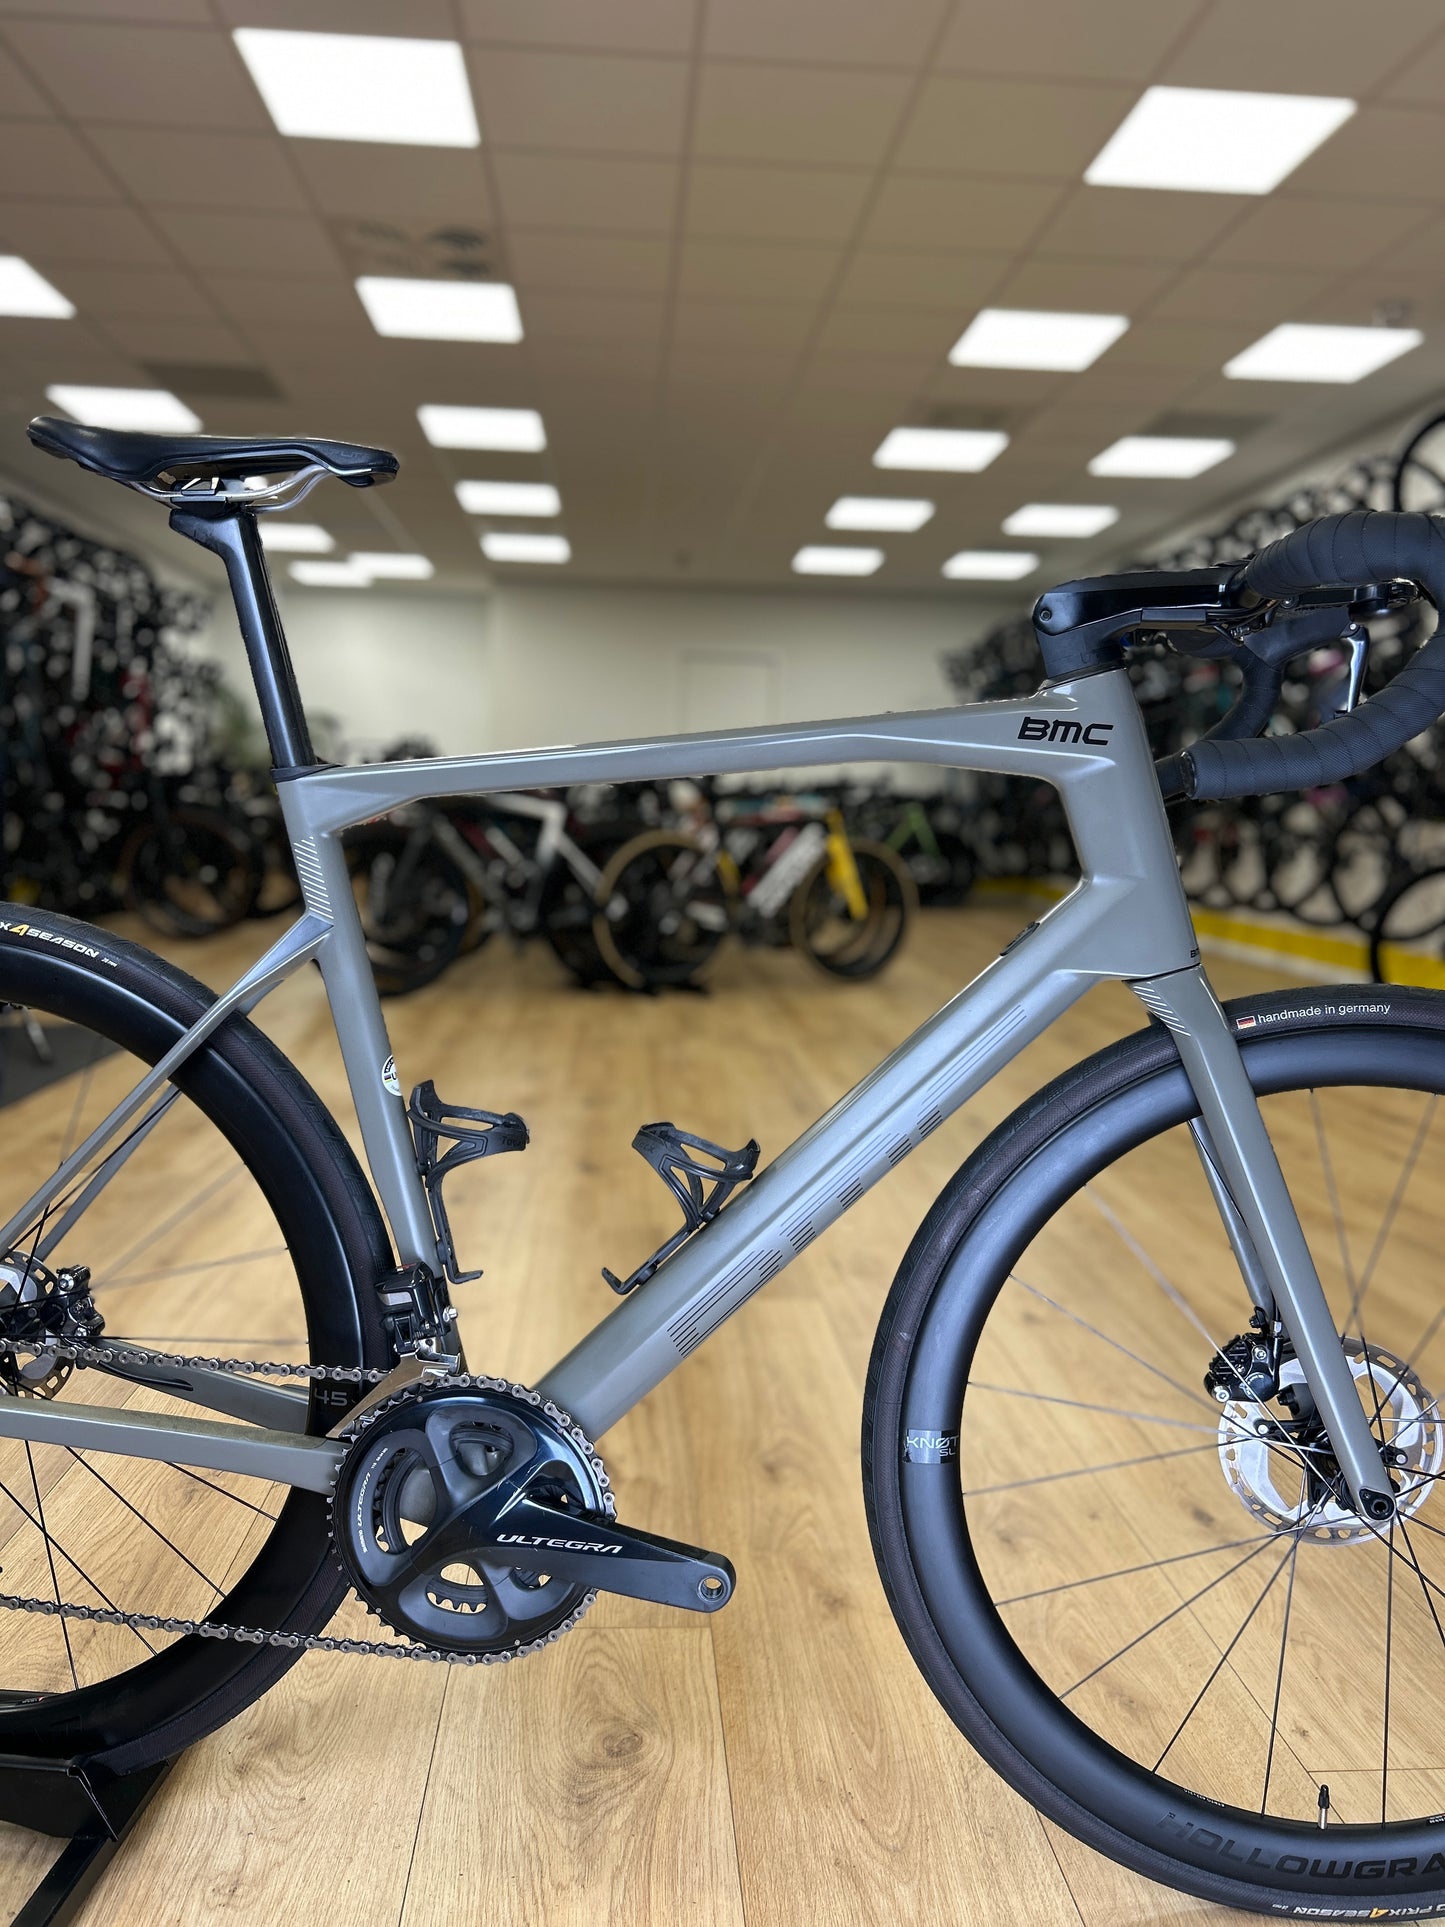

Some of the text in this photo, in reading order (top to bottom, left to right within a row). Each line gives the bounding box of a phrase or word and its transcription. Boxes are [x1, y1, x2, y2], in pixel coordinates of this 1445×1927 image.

[1018, 716, 1114, 746] BMC
[1257, 1003, 1391, 1024] handmade in germany
[314, 1387, 348, 1407] 45
[939, 1447, 957, 1457] SL
[357, 1472, 371, 1527] ULTEGRA
[496, 1533, 623, 1555] ULTEGRA
